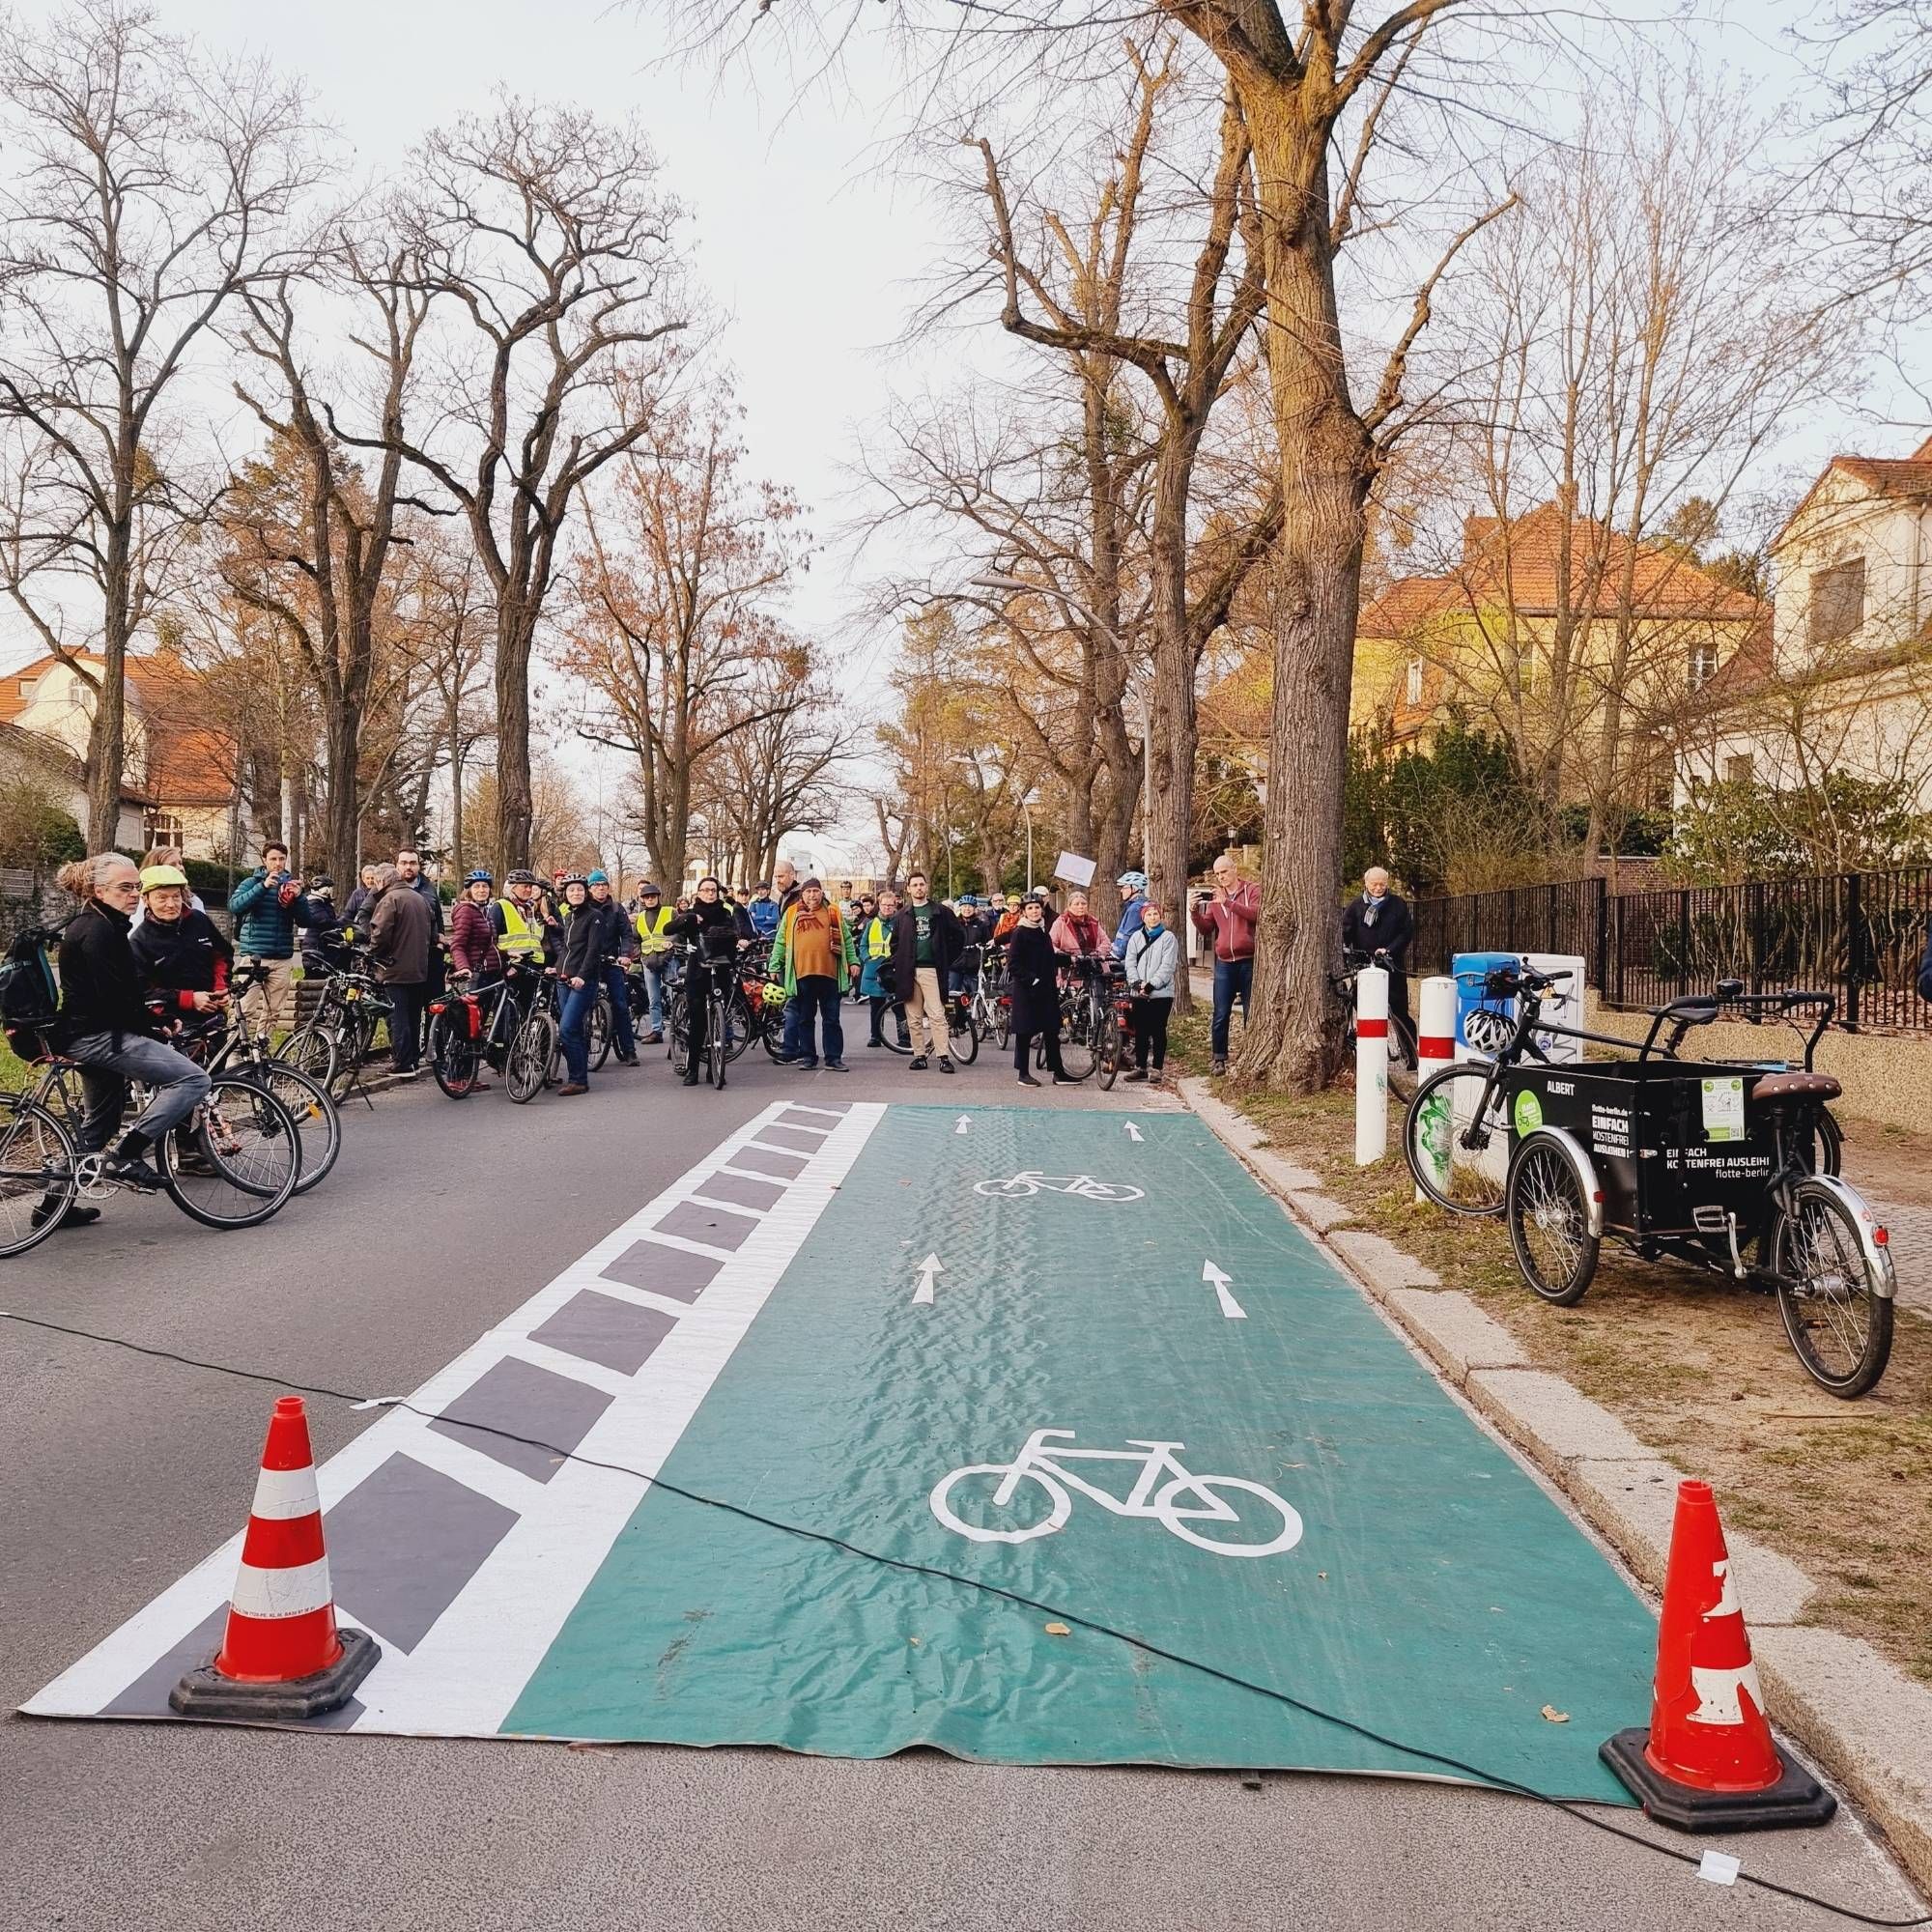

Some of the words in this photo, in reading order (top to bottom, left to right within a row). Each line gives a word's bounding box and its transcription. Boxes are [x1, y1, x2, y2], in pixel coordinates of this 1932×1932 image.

[1547, 1080, 1576, 1096] ALBERT
[1592, 1115, 1629, 1133] EINFACH
[1592, 1130, 1630, 1146] KOSTENFREI
